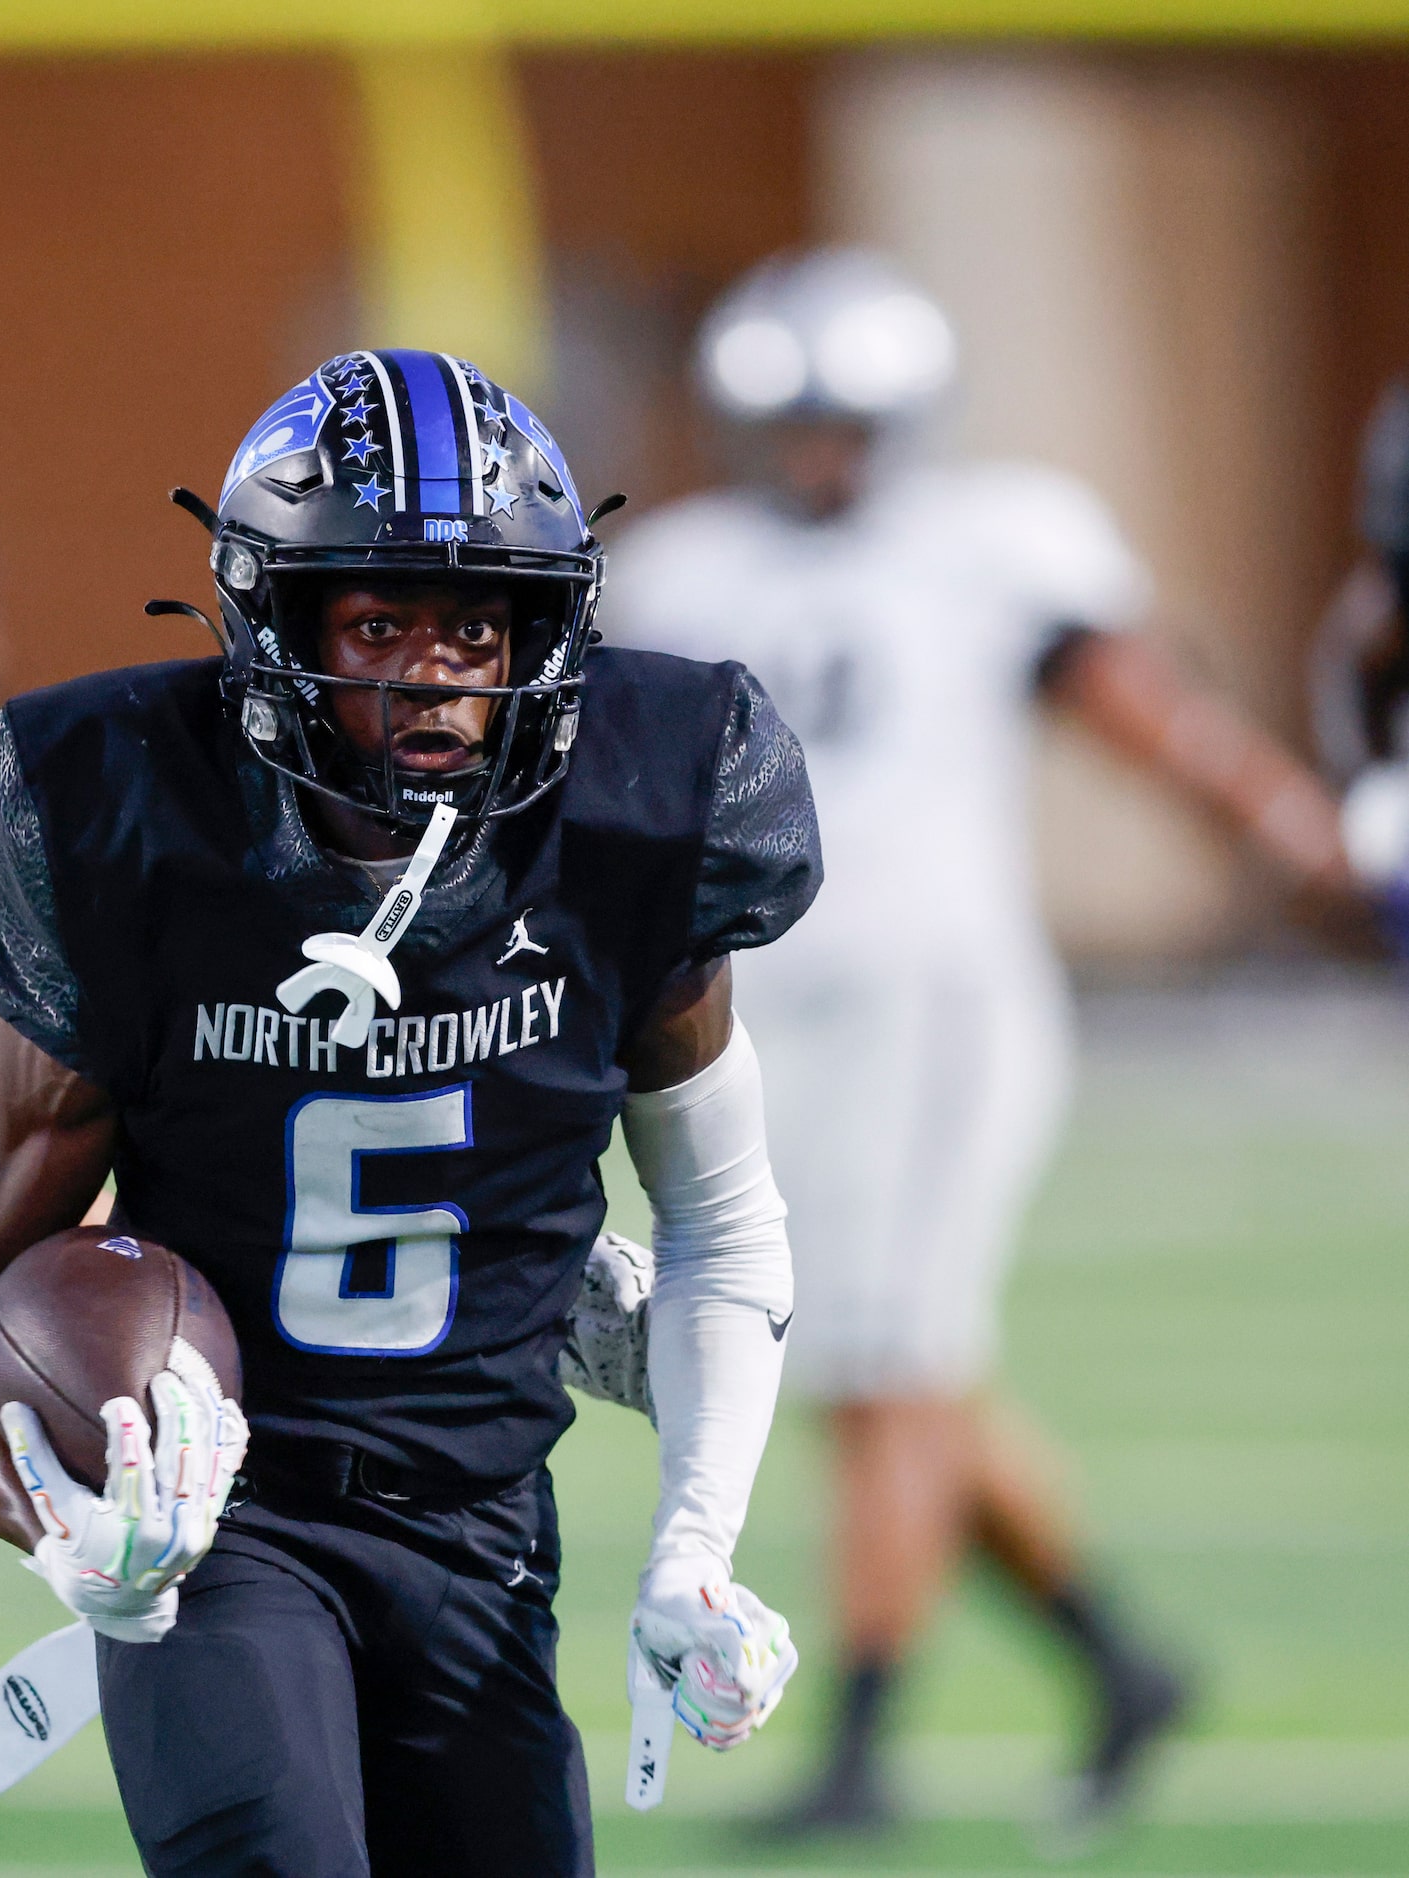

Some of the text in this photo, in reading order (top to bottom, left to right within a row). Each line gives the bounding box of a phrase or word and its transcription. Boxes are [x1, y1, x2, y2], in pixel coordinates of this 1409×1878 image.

[402, 788, 454, 803] Riddell
[378, 894, 410, 938] BATTLE
[193, 975, 568, 1079] NORTH CROWLEY
[271, 1081, 474, 1358] 6
